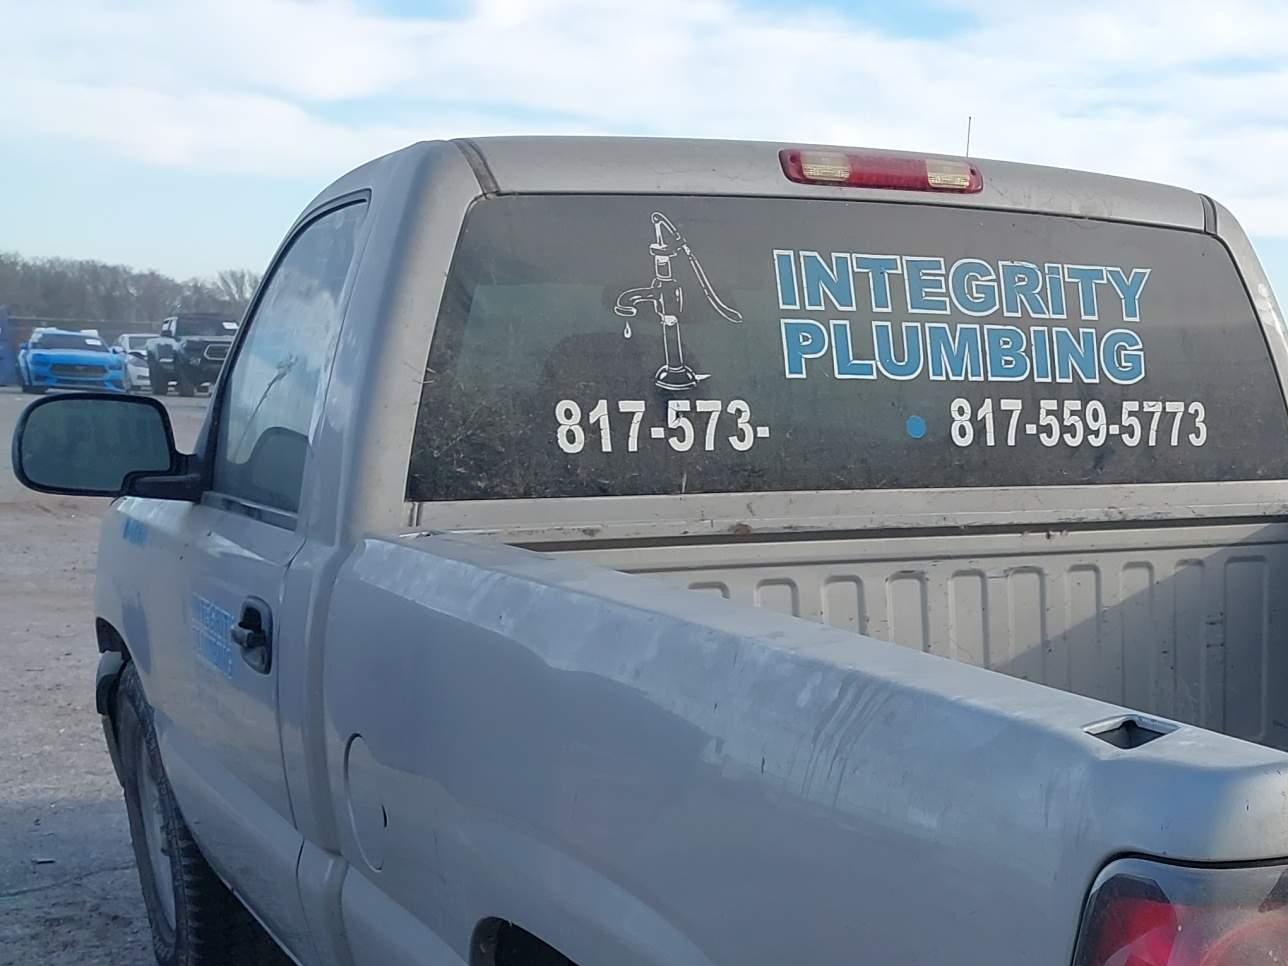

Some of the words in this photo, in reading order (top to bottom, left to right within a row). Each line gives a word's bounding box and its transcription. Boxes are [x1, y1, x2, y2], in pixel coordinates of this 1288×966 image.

[773, 249, 1151, 321] INTEGRITY
[779, 318, 1146, 384] PLUMBING
[553, 398, 771, 454] 817-573-
[949, 397, 1208, 448] 817-559-5773
